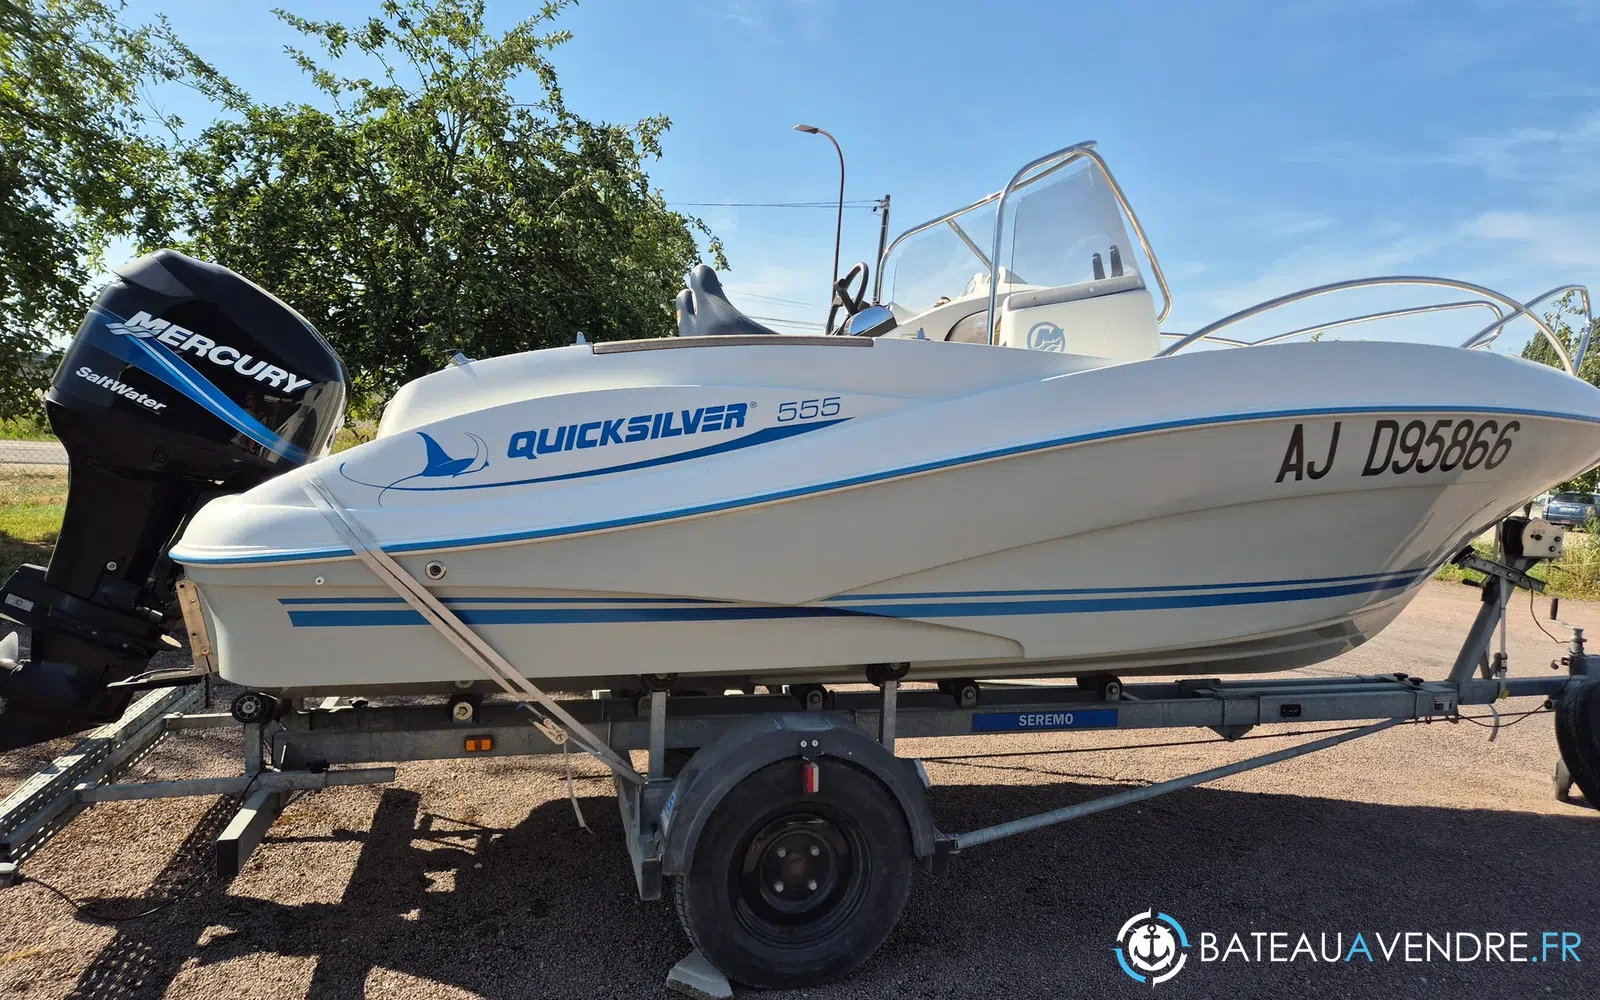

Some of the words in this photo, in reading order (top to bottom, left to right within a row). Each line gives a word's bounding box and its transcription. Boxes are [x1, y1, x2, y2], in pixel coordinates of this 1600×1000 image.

[123, 310, 312, 393] MERCURY
[75, 366, 167, 411] SaltWater
[507, 402, 747, 459] QUICKSILVER
[777, 396, 841, 422] 555
[1274, 421, 1342, 483] AJ
[1361, 418, 1521, 477] D95866
[1018, 713, 1074, 727] SEREMO
